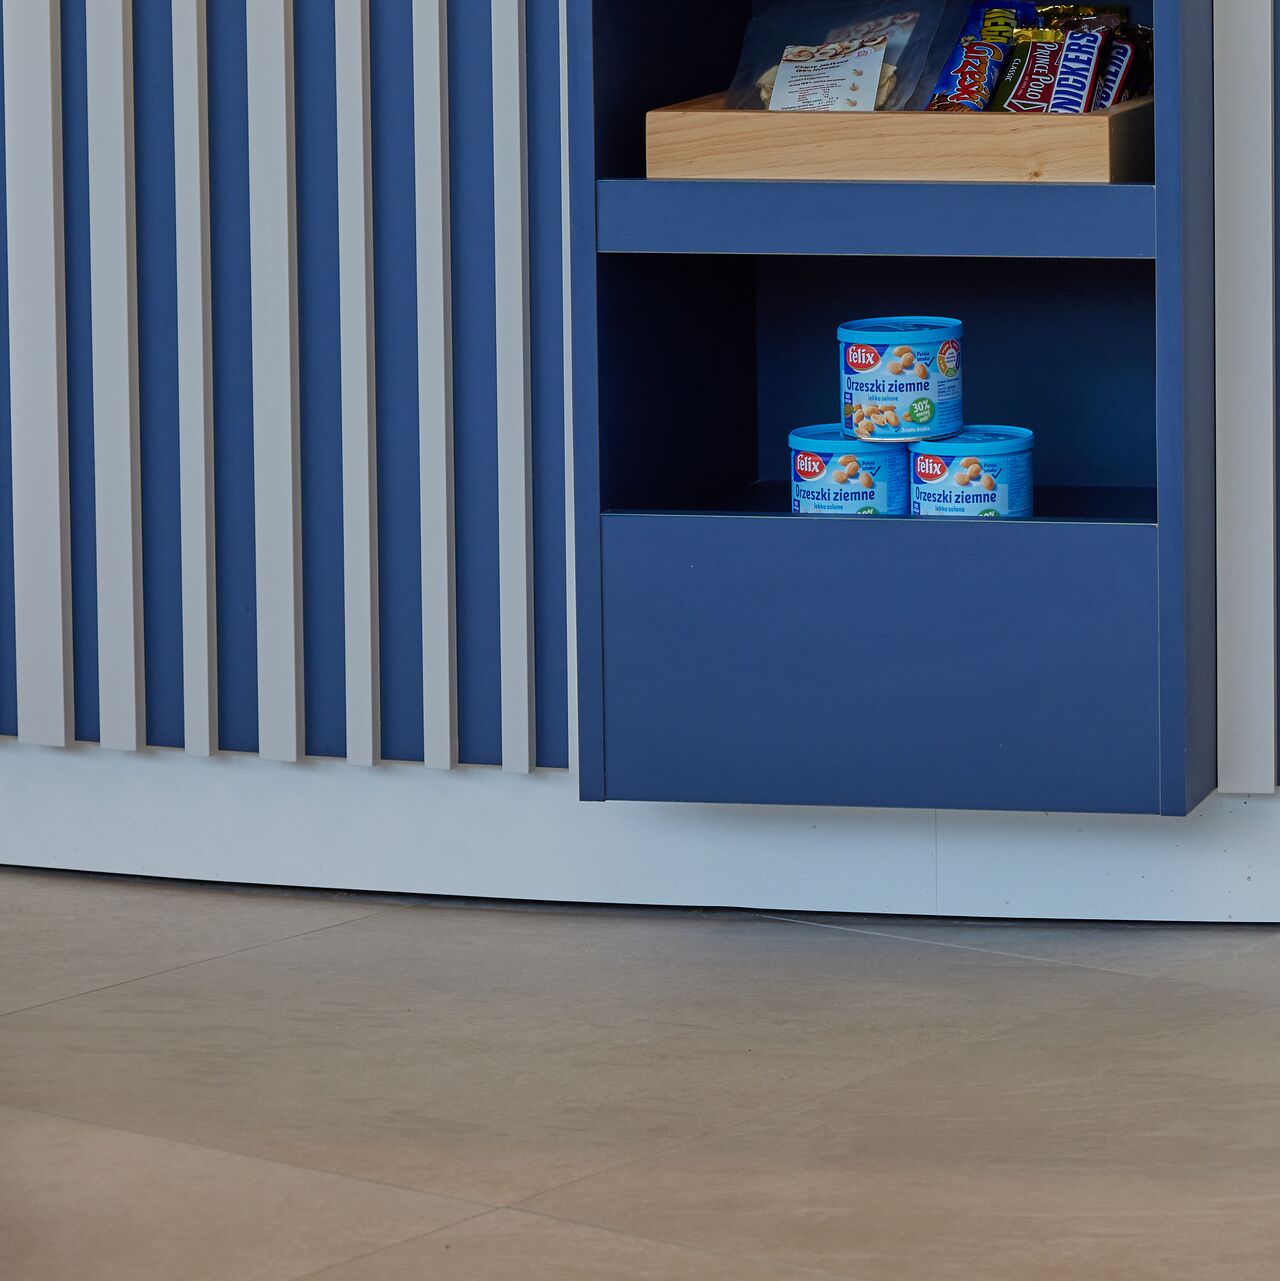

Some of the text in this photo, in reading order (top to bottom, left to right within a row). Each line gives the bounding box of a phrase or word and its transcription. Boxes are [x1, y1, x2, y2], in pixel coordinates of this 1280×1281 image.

[1004, 58, 1022, 82] CLASSIC
[1025, 42, 1059, 100] PRINCE POLO
[1050, 31, 1100, 113] NICKERS
[848, 346, 875, 365] felix
[846, 377, 930, 393] Orzeszki ziemne
[867, 394, 881, 402] lekko
[912, 399, 930, 413] 30%
[797, 454, 821, 473] felix
[917, 456, 942, 476] felix
[795, 485, 875, 501] Orzeszki ziemne
[915, 486, 997, 504] Orzeszki ziemne
